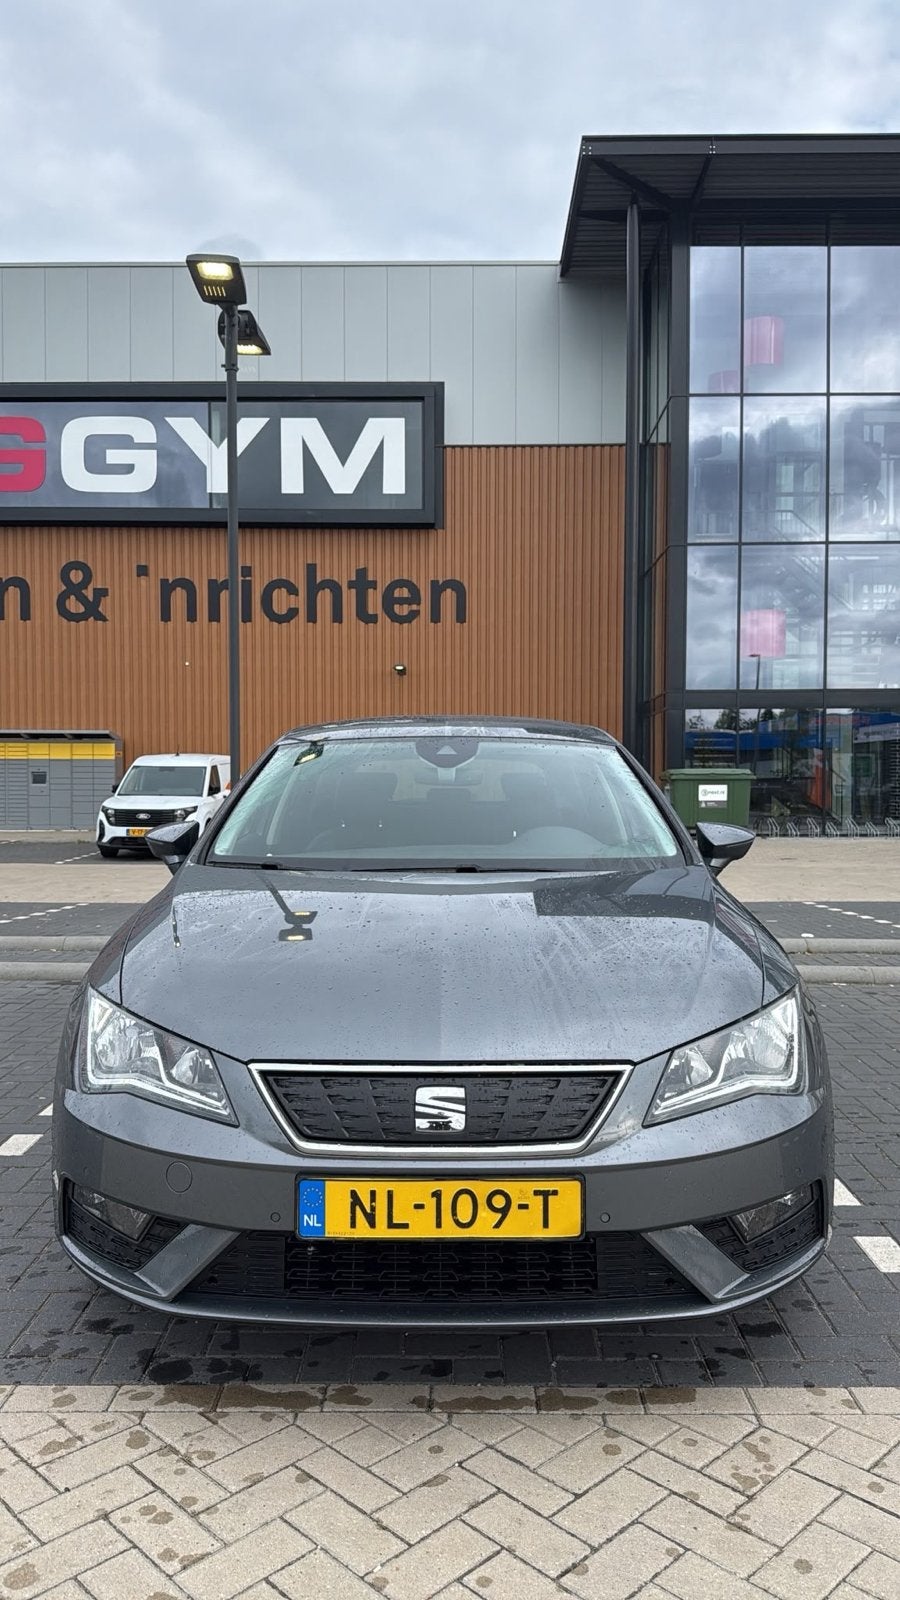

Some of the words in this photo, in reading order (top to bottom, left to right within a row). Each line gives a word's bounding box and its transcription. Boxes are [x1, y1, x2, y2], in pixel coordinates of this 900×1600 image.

[56, 560, 109, 623] &
[136, 563, 467, 624] nrichten
[303, 1214, 322, 1227] NL
[350, 1188, 558, 1230] NL-109-T
